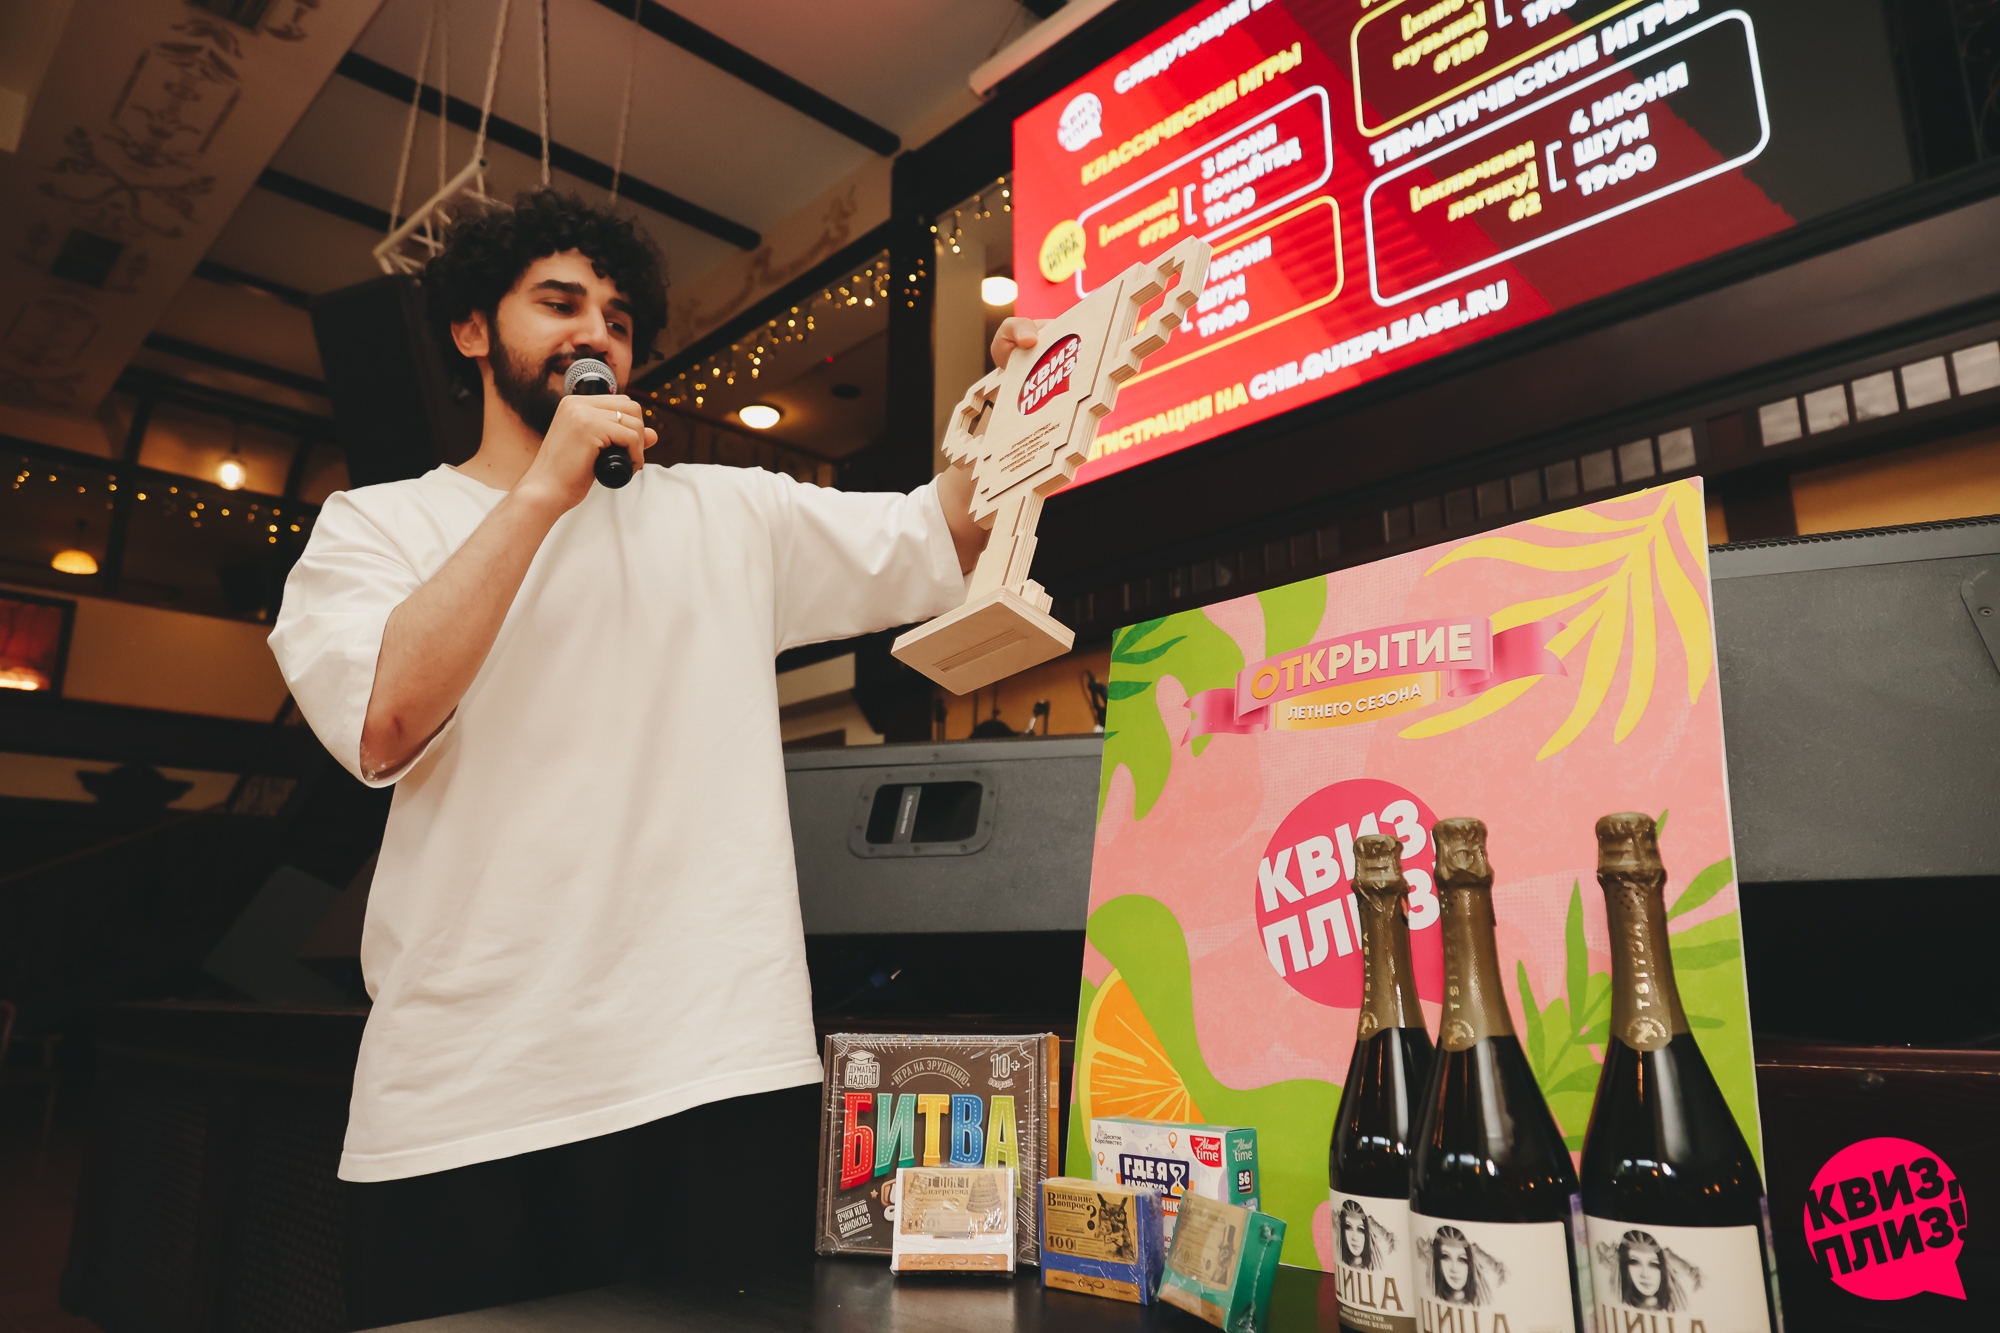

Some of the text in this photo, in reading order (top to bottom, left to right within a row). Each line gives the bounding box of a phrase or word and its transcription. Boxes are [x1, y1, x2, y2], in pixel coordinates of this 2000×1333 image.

[1369, 0, 1700, 167] ТЕМАТИЧЕСКИЕ ИГРЫ
[1569, 61, 1689, 135] 4 ИЮНЯ
[1081, 41, 1302, 186] КЛАССИЧЕСКИЕ ИГРЫ
[1201, 123, 1278, 180] 3 ИЮНЯ
[1573, 112, 1650, 167] ШУМ
[1409, 139, 1536, 213] [включаем
[1576, 143, 1658, 196] 19:00
[1203, 186, 1257, 228] 19:00
[1447, 160, 1539, 222] логику]
[1508, 191, 1542, 222] #2
[1209, 235, 1272, 283] ИЮНЯ
[1197, 273, 1246, 314] ШУМ
[1197, 299, 1250, 338] 19:00
[1215, 382, 1249, 414] НА
[1250, 624, 1473, 700] ОТКРЫТИЕ
[1287, 683, 1422, 722] ЛЕТНЕГО СЕЗОНА
[849, 1065, 872, 1074] ДУМАТЬ
[893, 1060, 970, 1087] ИГРА НА ЭРУДИЦИЮ
[990, 1053, 1021, 1078] 10+
[840, 1092, 1022, 1198] БИТВА
[1196, 1148, 1219, 1162] time
[1124, 1157, 1168, 1181] ГДЕ Я
[1238, 1171, 1250, 1186] 56
[837, 1203, 869, 1223] ОЧКИ ИЛИ
[839, 1212, 872, 1234] БИНОКЛЬ?
